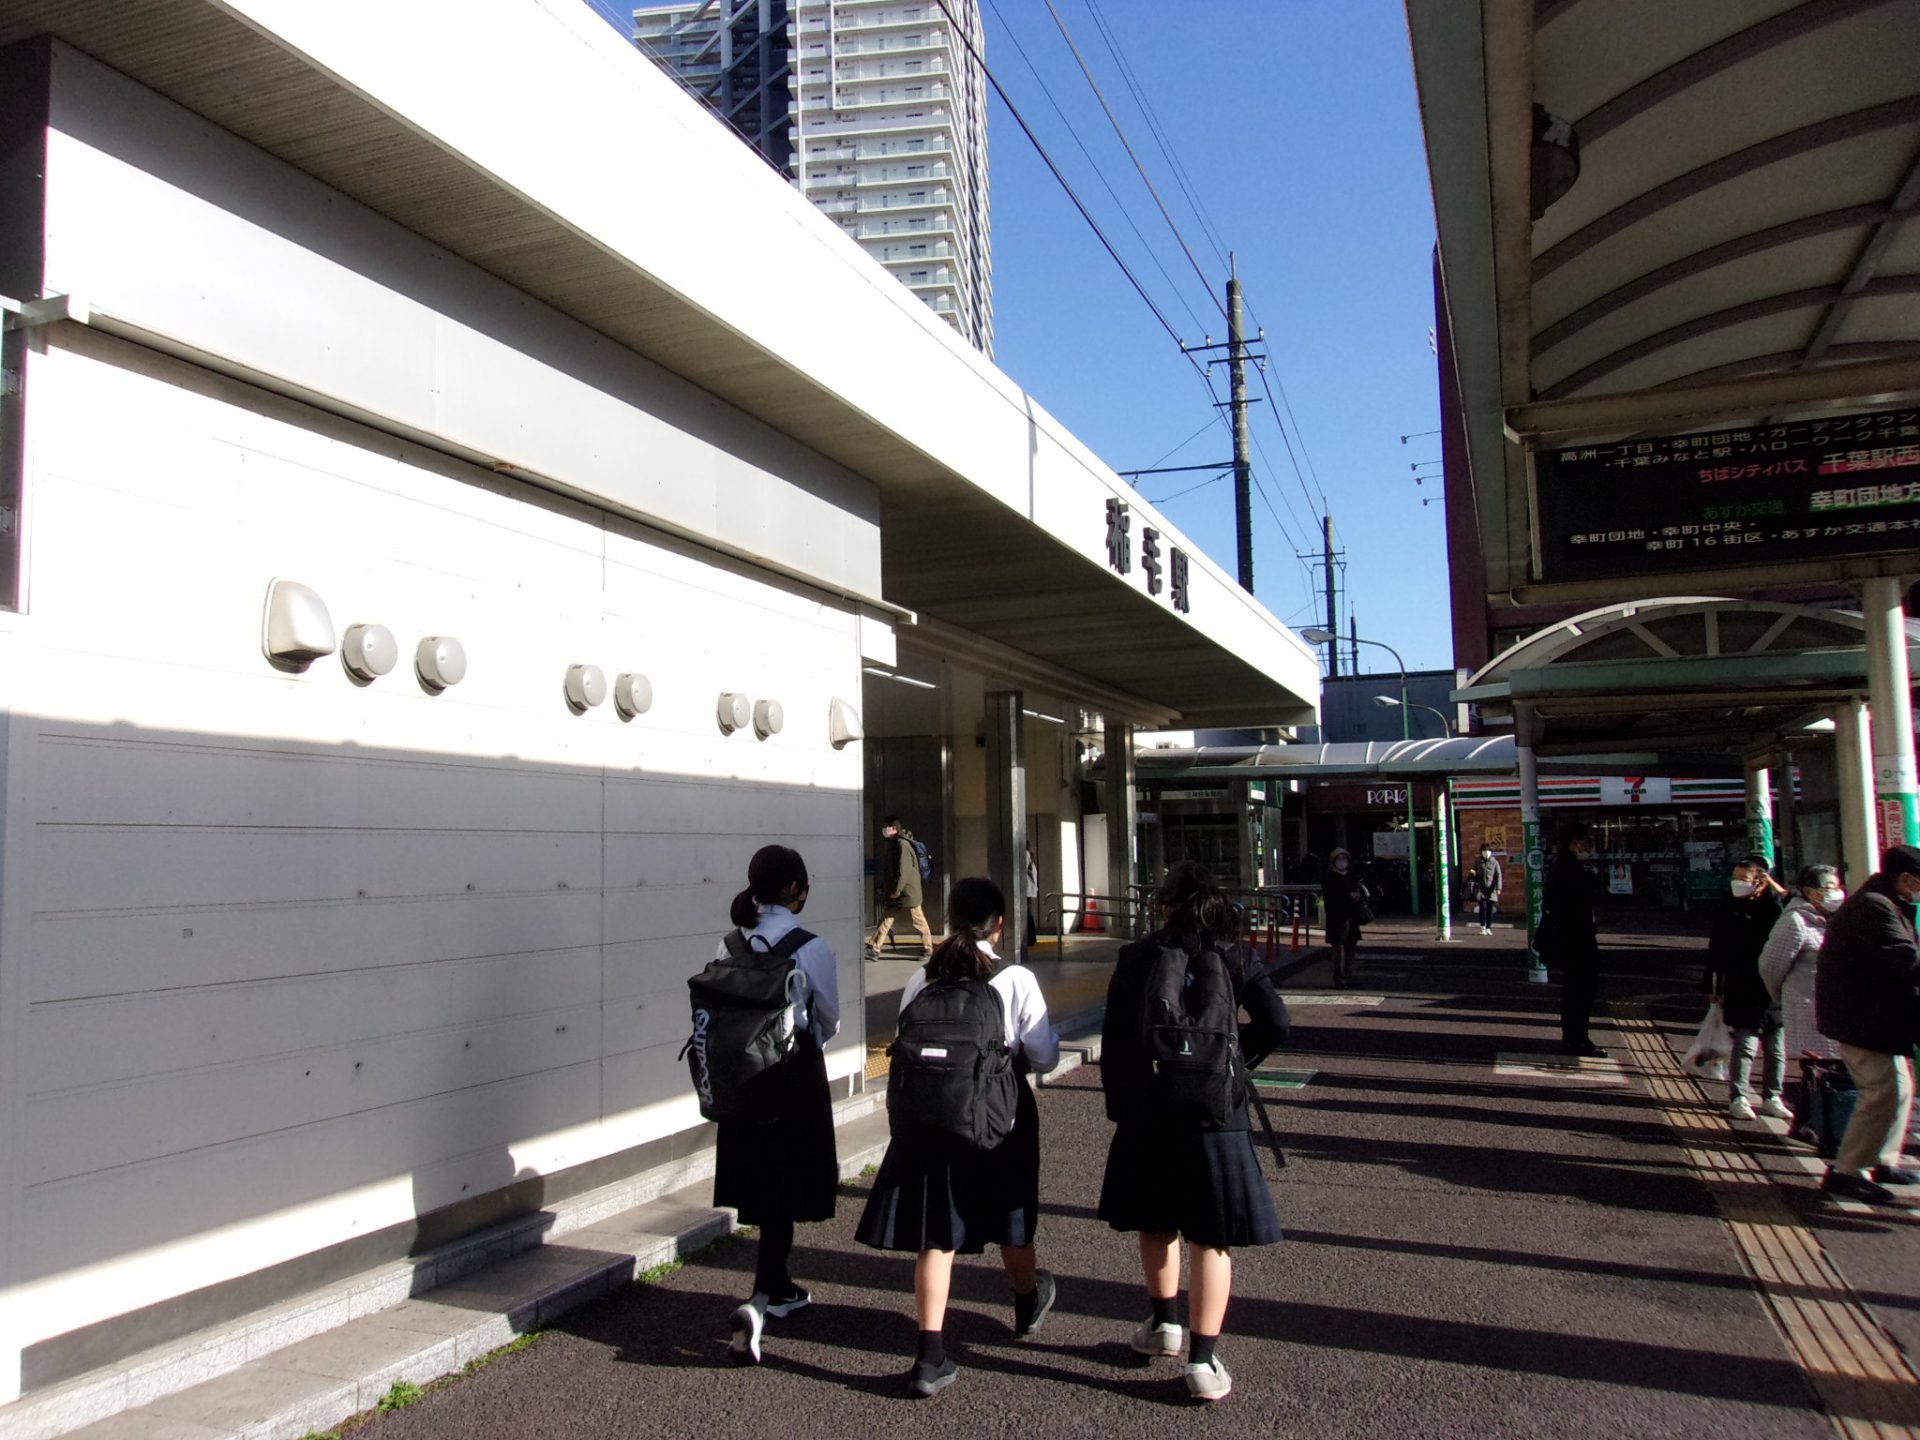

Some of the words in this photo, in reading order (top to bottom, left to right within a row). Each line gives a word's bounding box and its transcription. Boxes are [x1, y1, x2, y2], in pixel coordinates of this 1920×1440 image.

[1697, 458, 1809, 483] ちばシティバス
[1105, 497, 1190, 614] 稲毛駅
